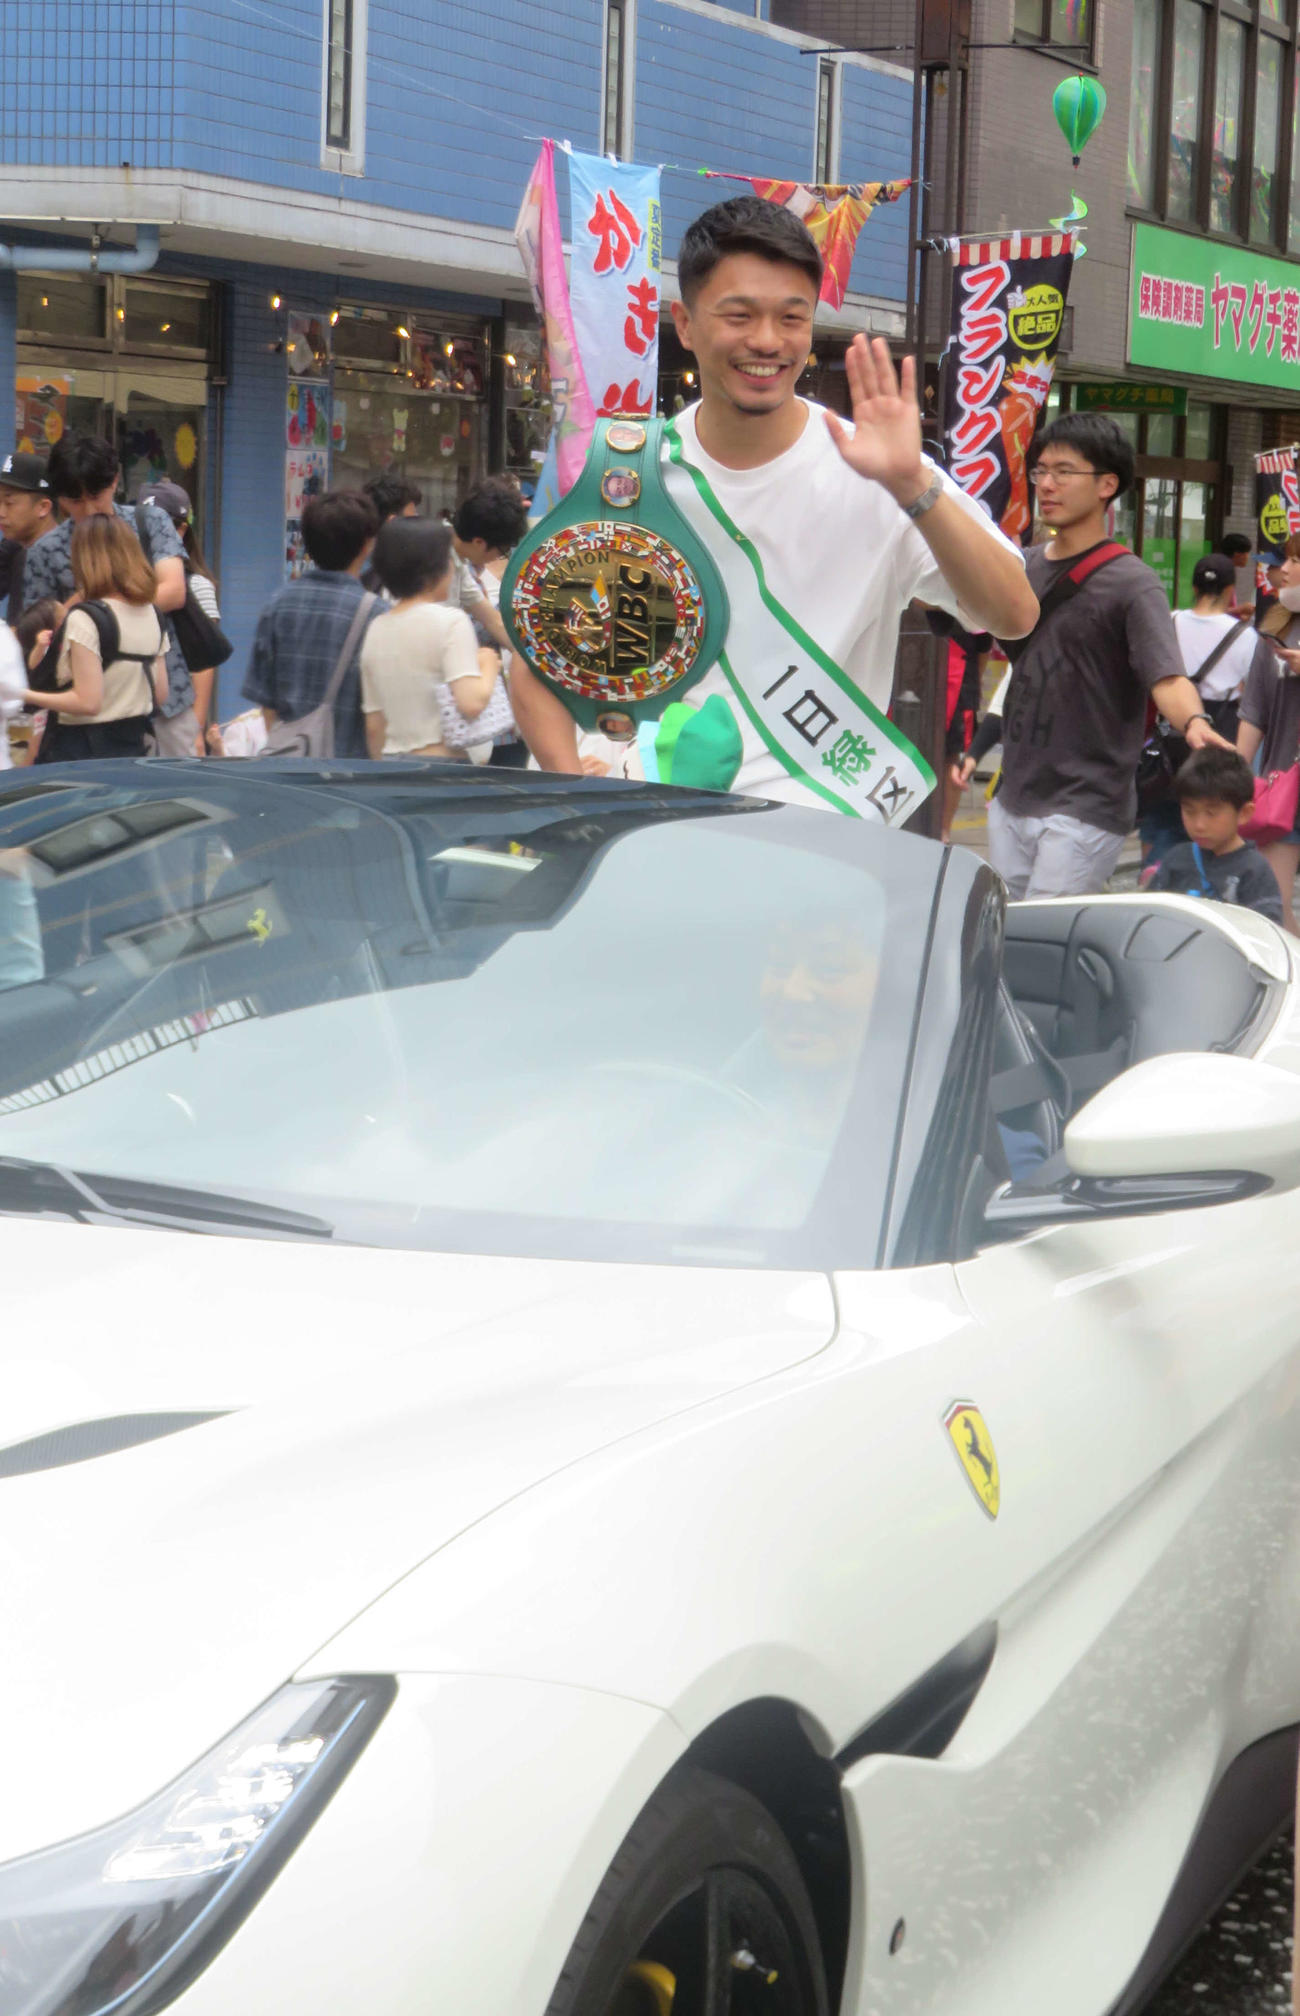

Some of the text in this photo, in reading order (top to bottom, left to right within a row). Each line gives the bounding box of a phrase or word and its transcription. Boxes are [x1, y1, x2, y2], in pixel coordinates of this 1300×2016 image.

[1016, 313, 1057, 336] 絶品
[1139, 272, 1205, 328] 保険調剤薬局
[1210, 272, 1300, 362] ヤマグチ薬
[951, 260, 1010, 518] フランクフ
[540, 550, 611, 623] CHAMPION
[617, 562, 652, 667] WBC
